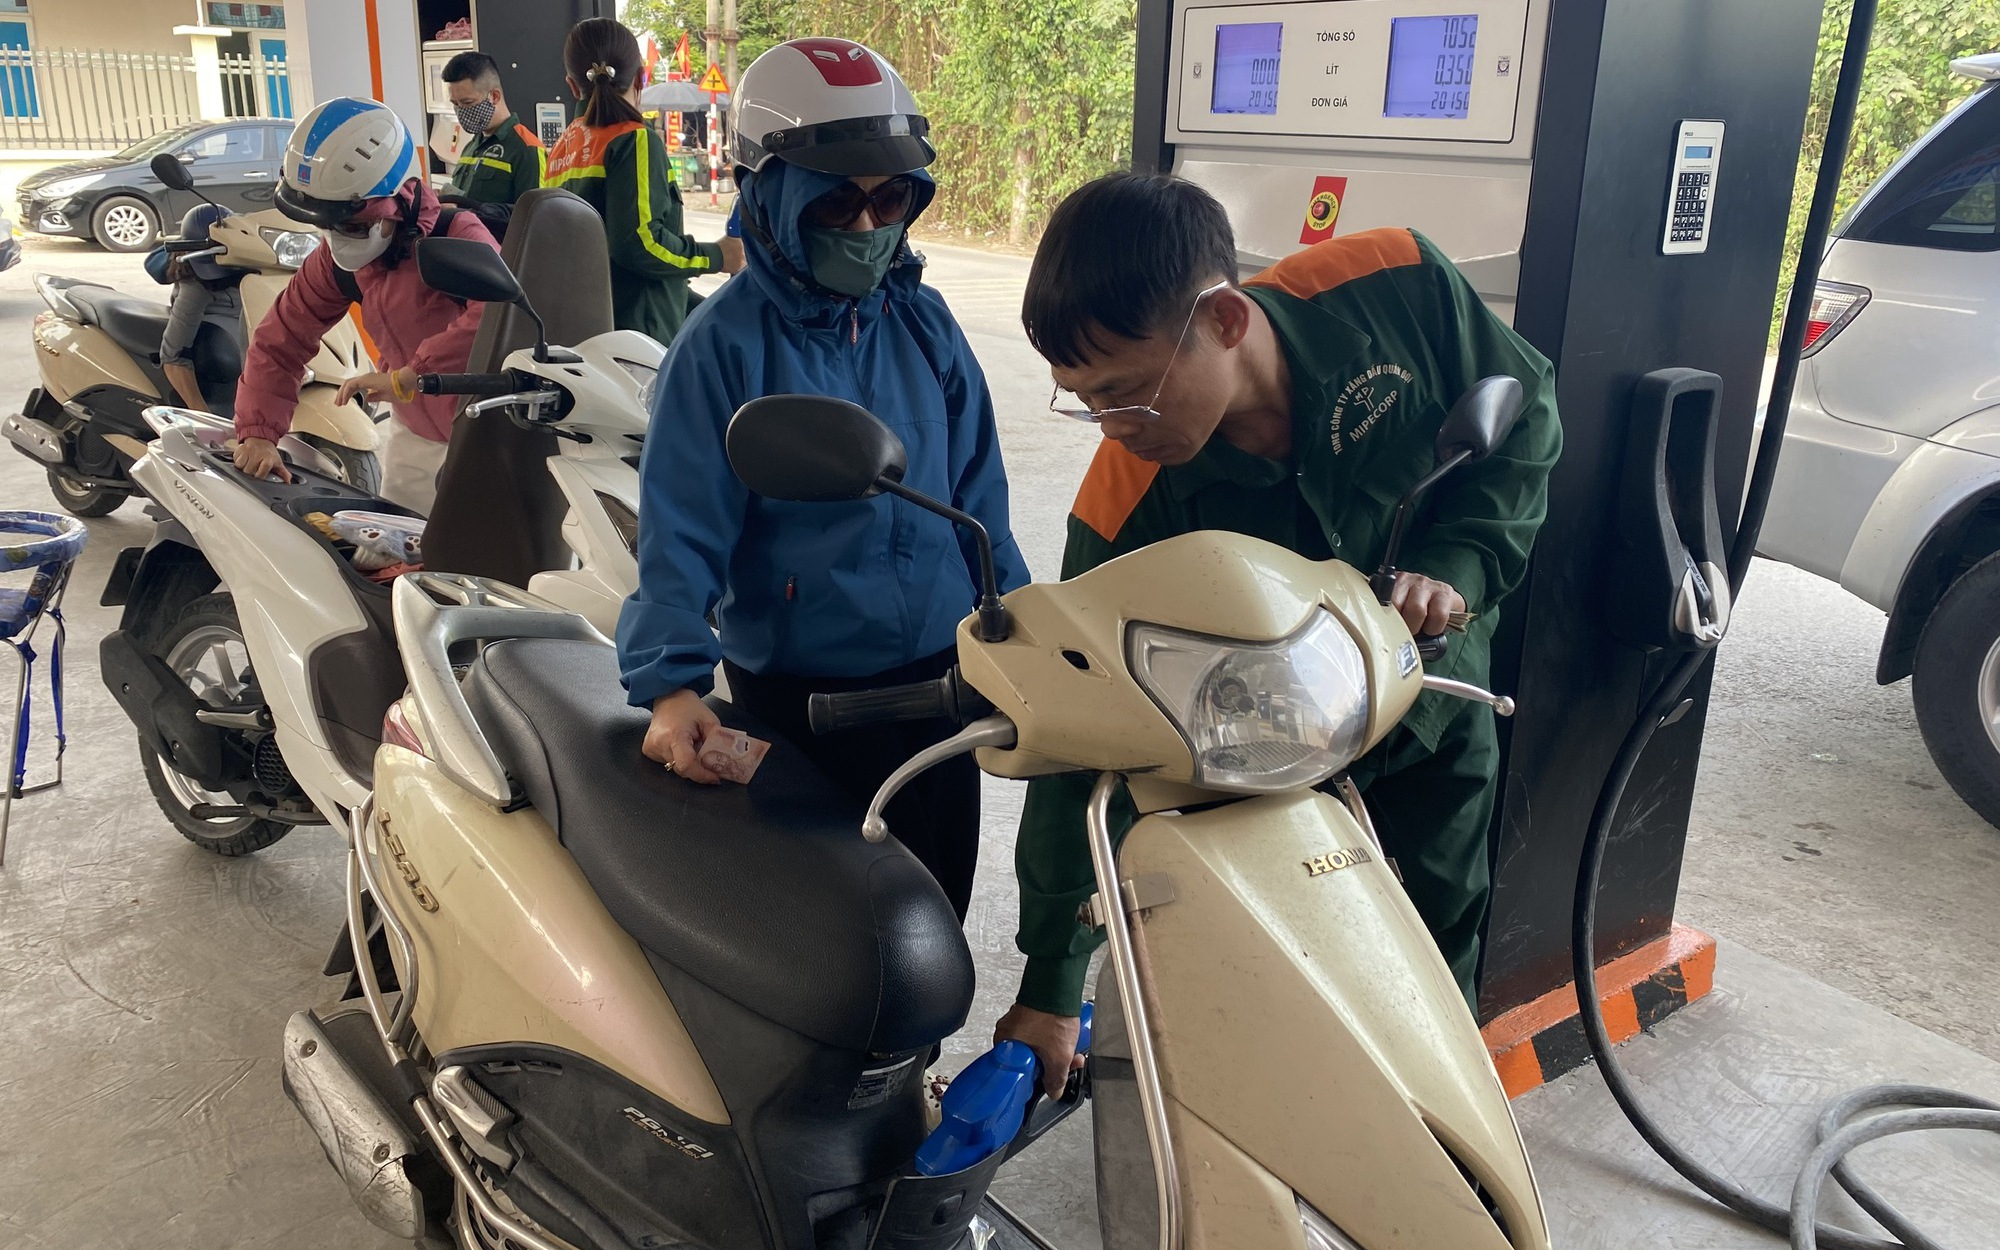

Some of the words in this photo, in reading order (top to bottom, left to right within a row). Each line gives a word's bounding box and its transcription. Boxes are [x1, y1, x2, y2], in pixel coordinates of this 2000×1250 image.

[1326, 62, 1339, 75] LÍT
[1333, 95, 1348, 107] GIÁ
[1312, 221, 1327, 229] STOP
[1337, 393, 1349, 405] TY
[1349, 390, 1398, 442] MIPECORP
[174, 480, 215, 519] VISION
[377, 807, 439, 913] LEAD
[625, 1114, 649, 1131] FUEL
[651, 1130, 701, 1159] INJECTION
